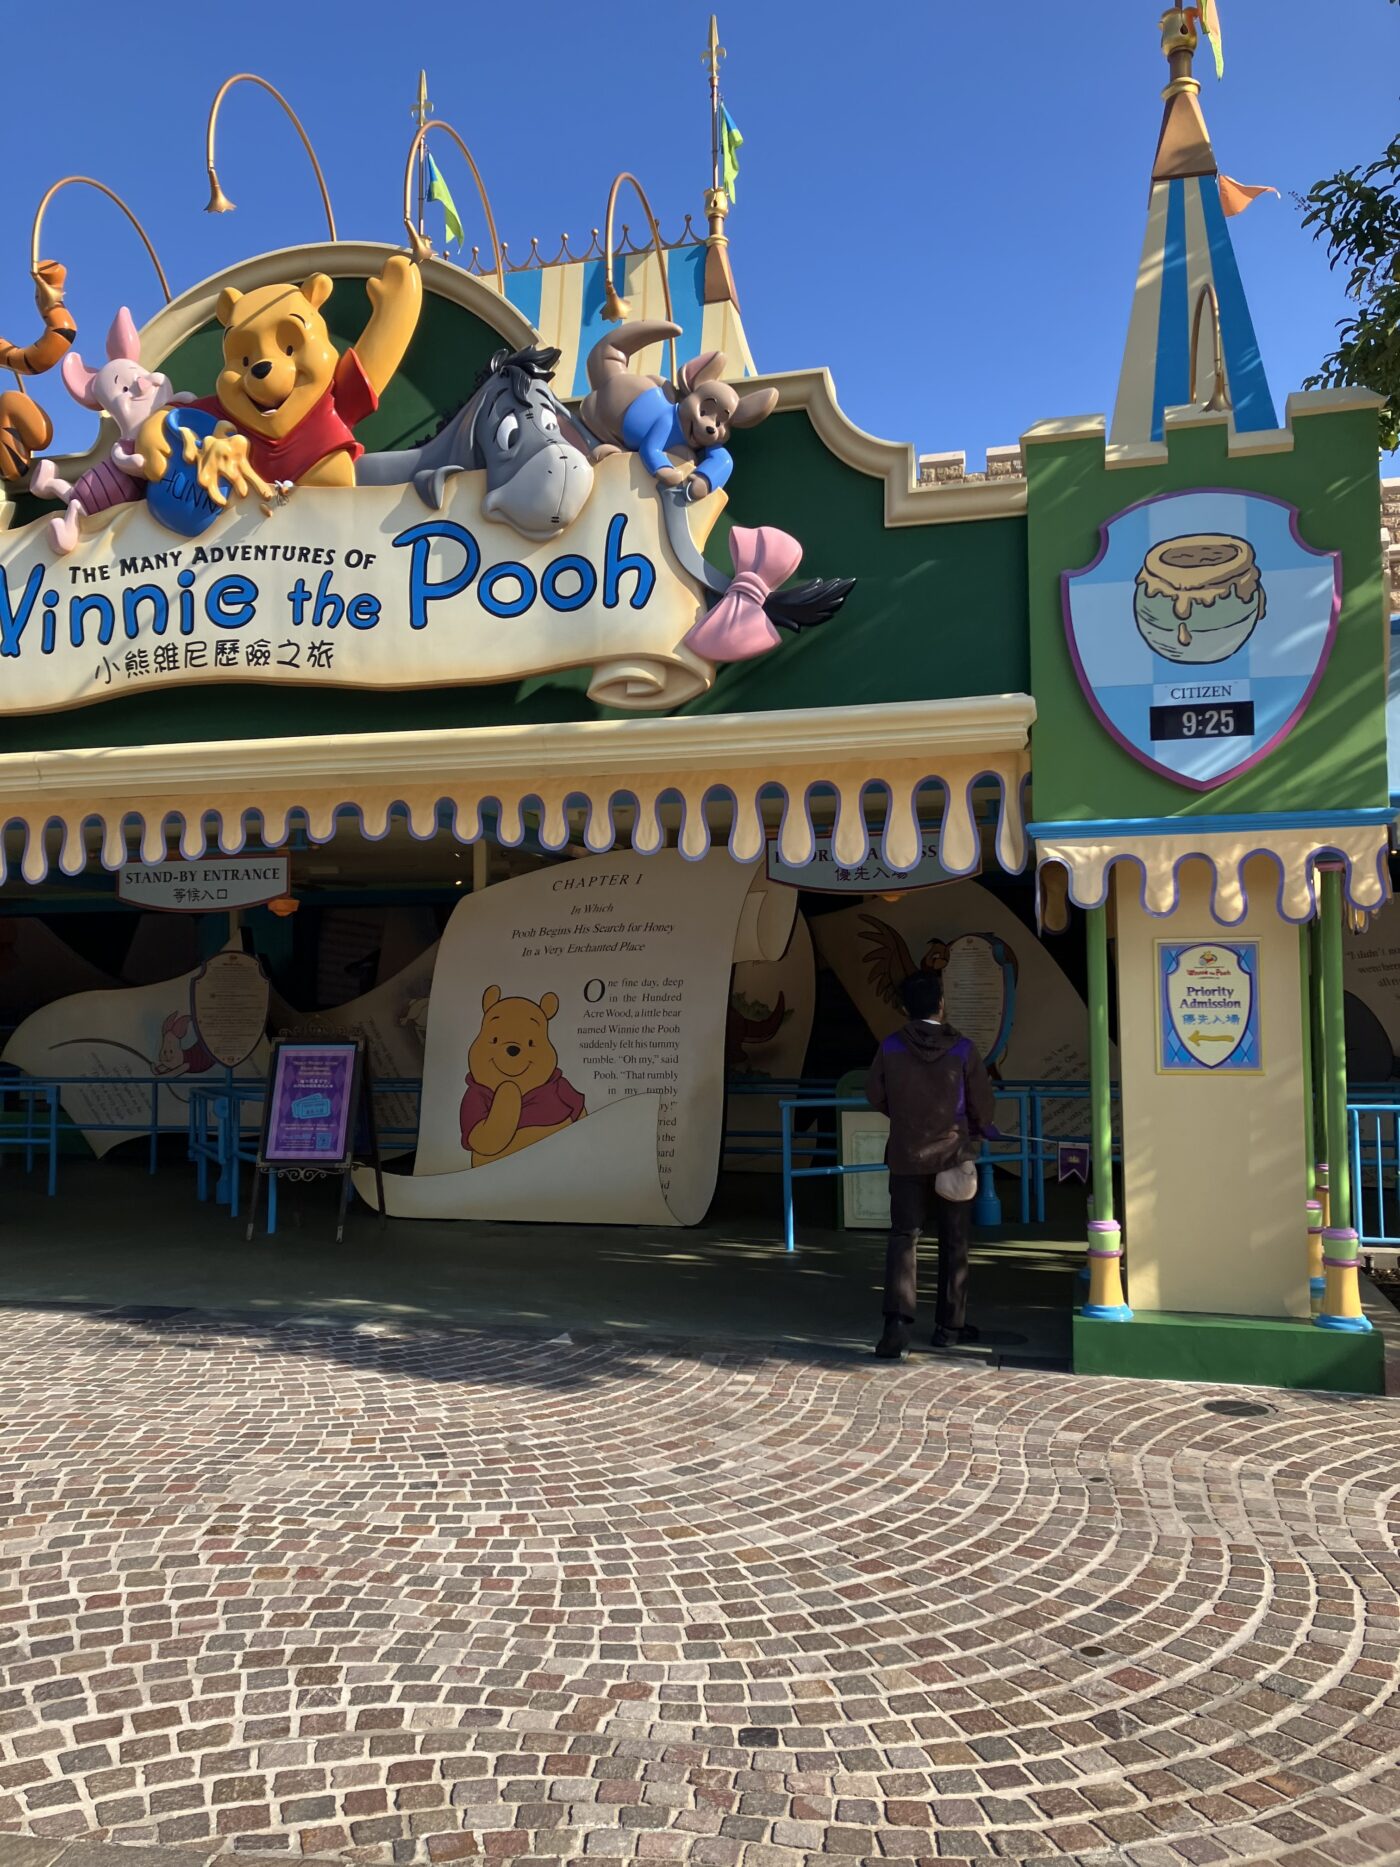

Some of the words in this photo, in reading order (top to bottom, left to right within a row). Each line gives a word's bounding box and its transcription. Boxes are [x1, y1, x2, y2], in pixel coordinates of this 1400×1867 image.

[68, 565, 111, 585] THE
[119, 550, 183, 578] MANY
[191, 545, 336, 567] ADVENTURES
[343, 549, 377, 571] OF
[286, 569, 382, 631] the
[391, 512, 657, 630] Pooh
[94, 638, 336, 685] 小熊維尼歷險之旅
[1170, 684, 1232, 700] CITIZEN
[1181, 709, 1235, 737] 9:25
[125, 870, 198, 885] STAND-BY
[203, 868, 281, 882] ENTRANCE
[552, 873, 629, 892] CHAPTER
[173, 888, 229, 904] 等候入口
[570, 905, 581, 915] In
[584, 903, 614, 914] Which
[511, 928, 537, 939] Pooh
[539, 926, 572, 938] Begins
[574, 924, 591, 935] His
[594, 923, 625, 933] Search
[627, 922, 642, 932] for
[644, 922, 675, 934] Honey
[521, 947, 532, 957] In
[567, 942, 618, 954] Enchanted
[619, 941, 646, 952] Place
[621, 978, 638, 987] fine
[662, 977, 684, 988] deep
[609, 994, 618, 1002] in
[623, 993, 637, 1002] the
[642, 993, 682, 1002] Hundred
[1186, 986, 1234, 999] Priority
[1180, 998, 1241, 1009] Admission
[583, 1010, 604, 1018] Acre
[606, 1009, 633, 1019] Wood,
[641, 1009, 661, 1018] little
[662, 1009, 682, 1018] bear
[577, 1025, 606, 1034] named
[608, 1025, 640, 1034] Winnie
[642, 1025, 655, 1034] the
[657, 1025, 681, 1034] Pooh
[579, 1040, 617, 1051] suddenly
[619, 1039, 634, 1049] felt
[635, 1040, 648, 1049] his
[649, 1040, 680, 1051] tummy
[661, 1055, 679, 1064] said
[647, 1071, 679, 1082] rumbly
[608, 1086, 616, 1095] in
[624, 1088, 638, 1097] my
